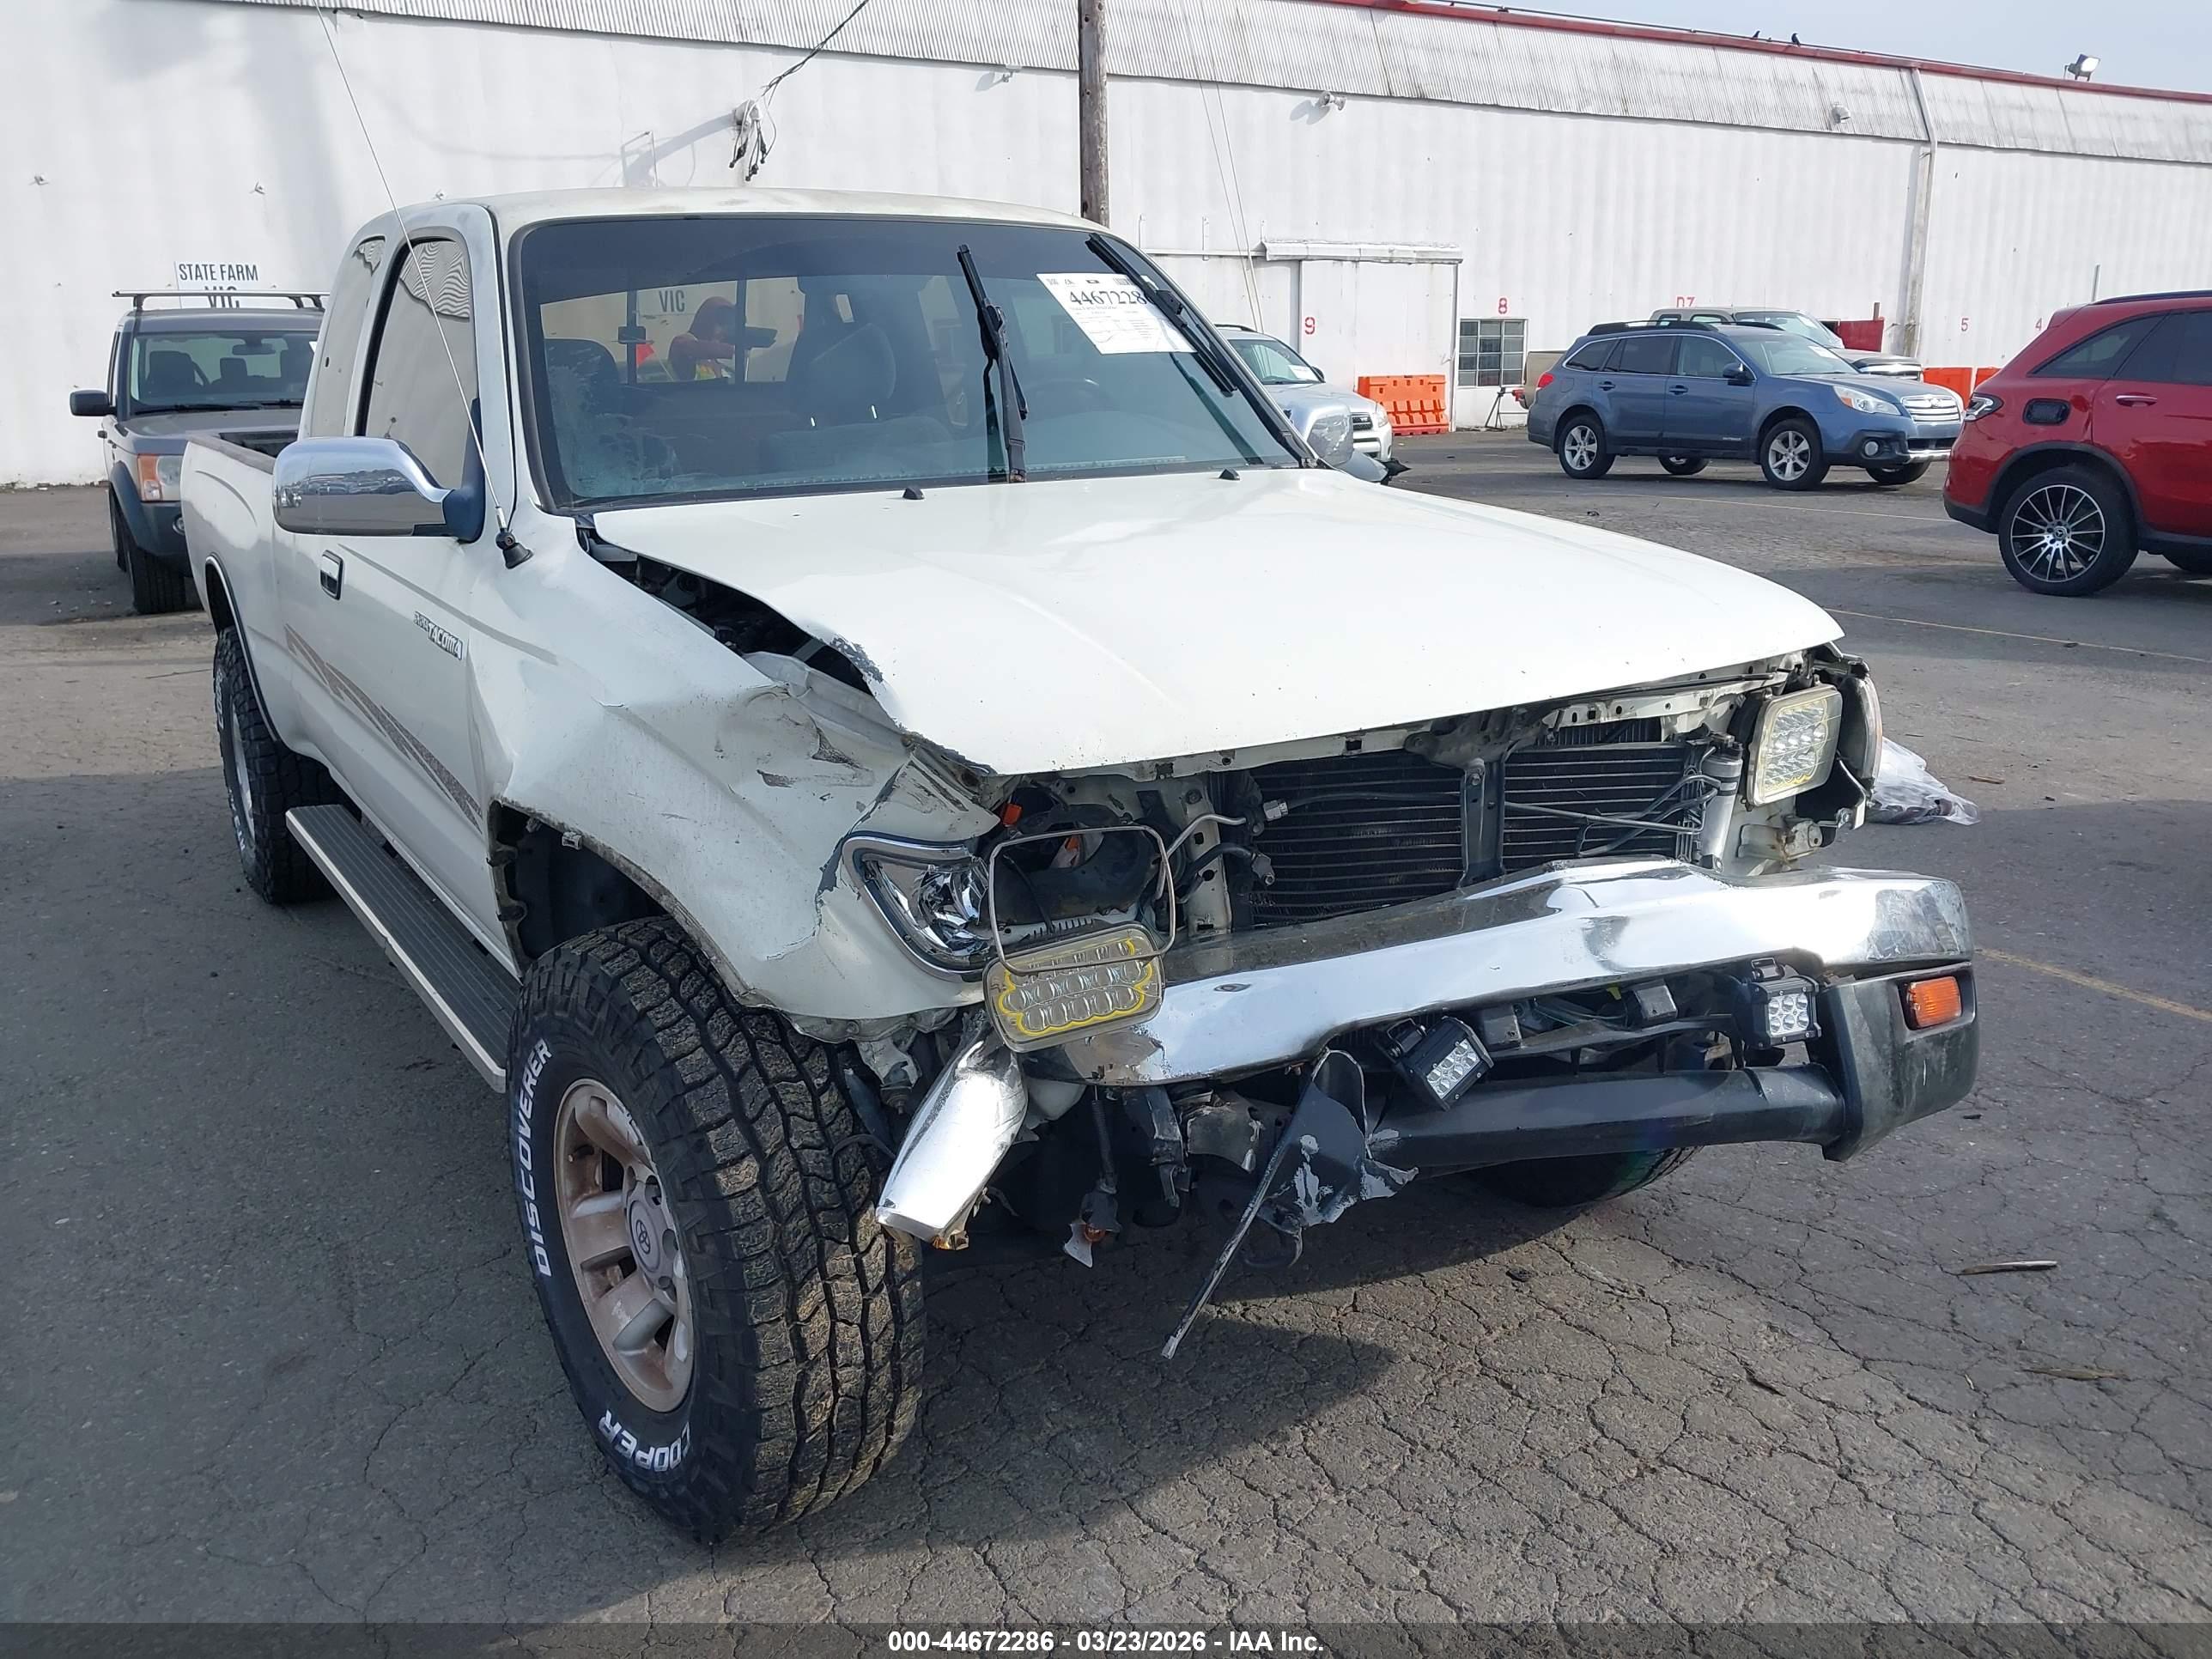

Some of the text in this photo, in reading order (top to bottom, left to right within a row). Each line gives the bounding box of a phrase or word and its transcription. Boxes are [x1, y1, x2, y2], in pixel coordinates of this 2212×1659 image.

[179, 264, 258, 281] STATE FARM
[659, 290, 685, 313] VIC
[1069, 290, 1157, 306] 4467228
[1498, 297, 1508, 314] 8
[1304, 317, 1316, 335] 9
[1961, 318, 1969, 331] 5
[2035, 317, 2043, 331] 4
[428, 621, 463, 660] TACOMA
[518, 1037, 553, 1278] DISCOVERER
[599, 1409, 690, 1473] COOPER
